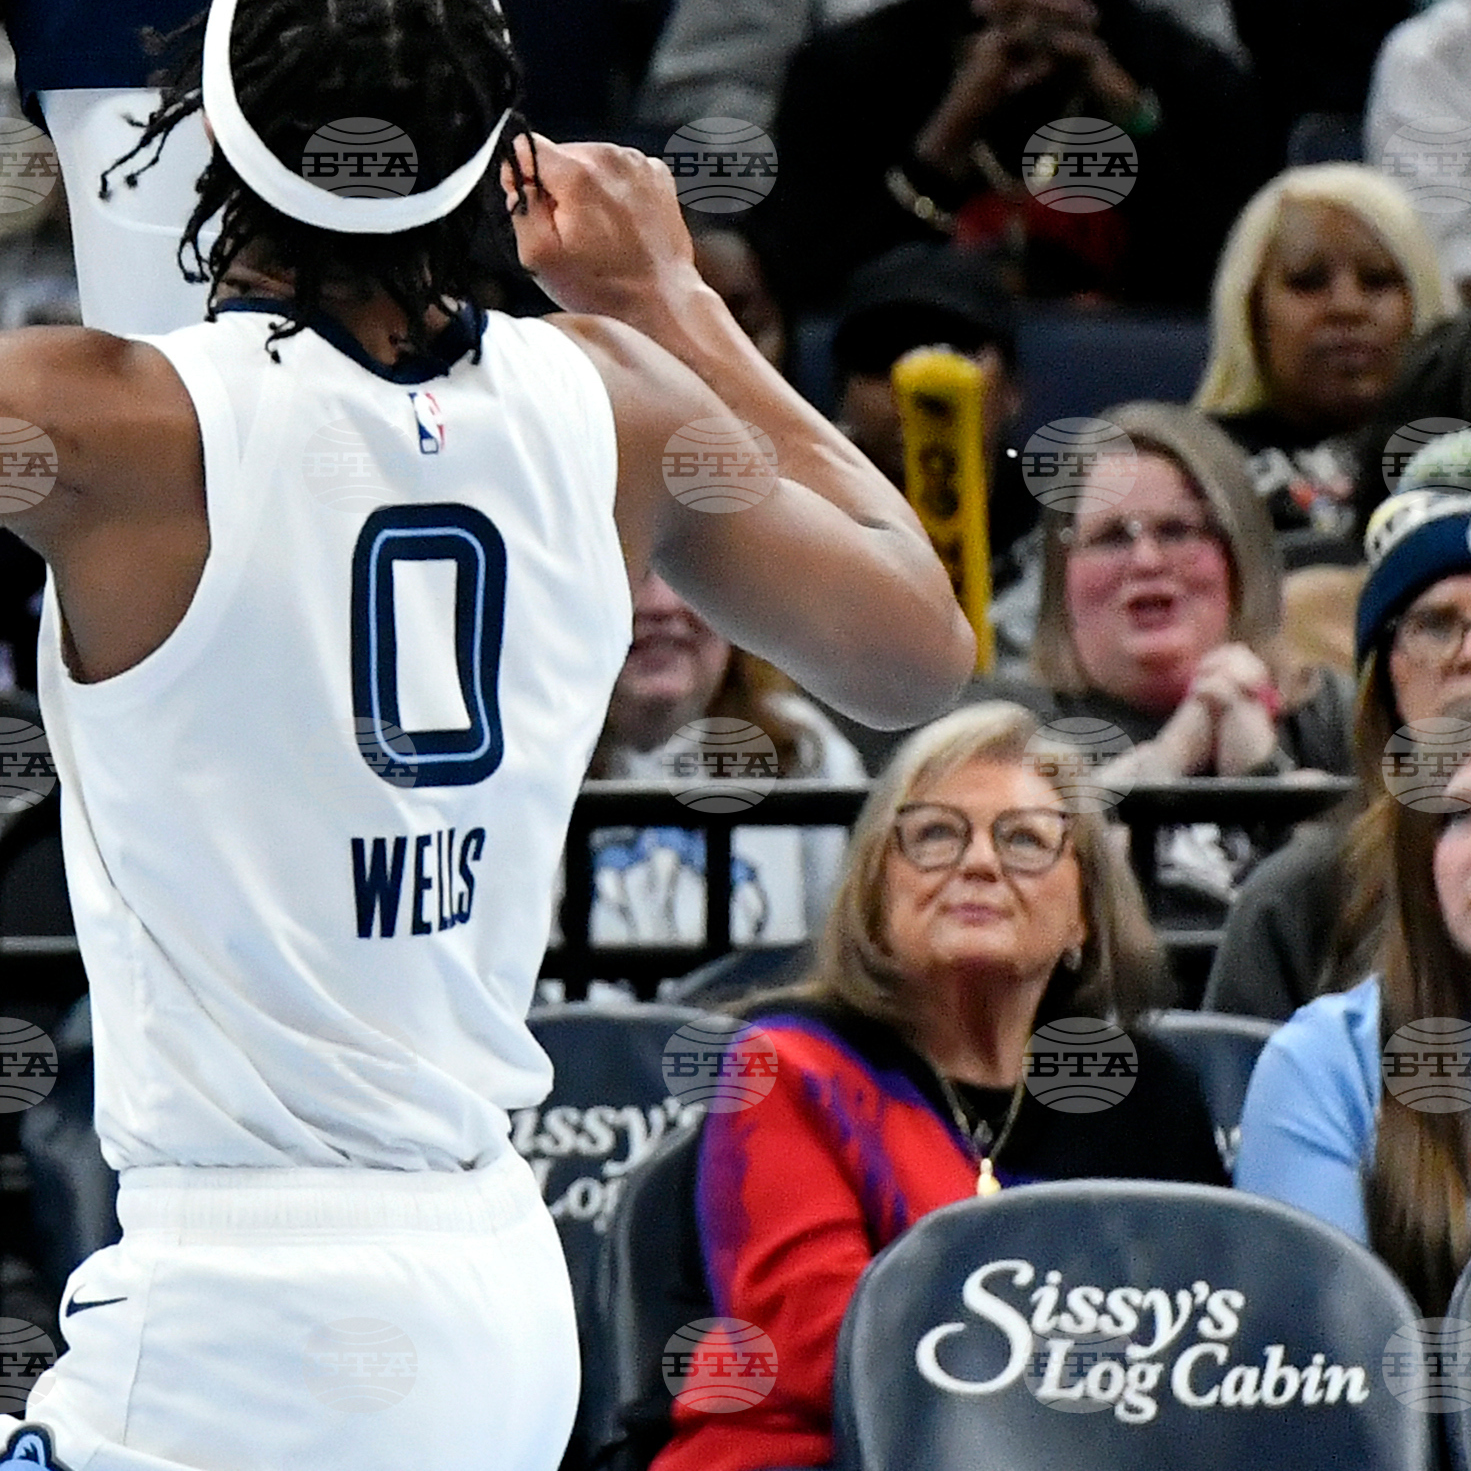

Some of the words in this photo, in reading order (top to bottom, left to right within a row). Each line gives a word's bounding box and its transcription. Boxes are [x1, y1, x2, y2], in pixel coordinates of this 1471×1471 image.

[351, 502, 507, 788] 0
[350, 826, 487, 940] WELLS
[916, 1259, 1246, 1395] Sissy's
[1036, 1337, 1164, 1425] Log
[1171, 1342, 1370, 1407] Cabin
